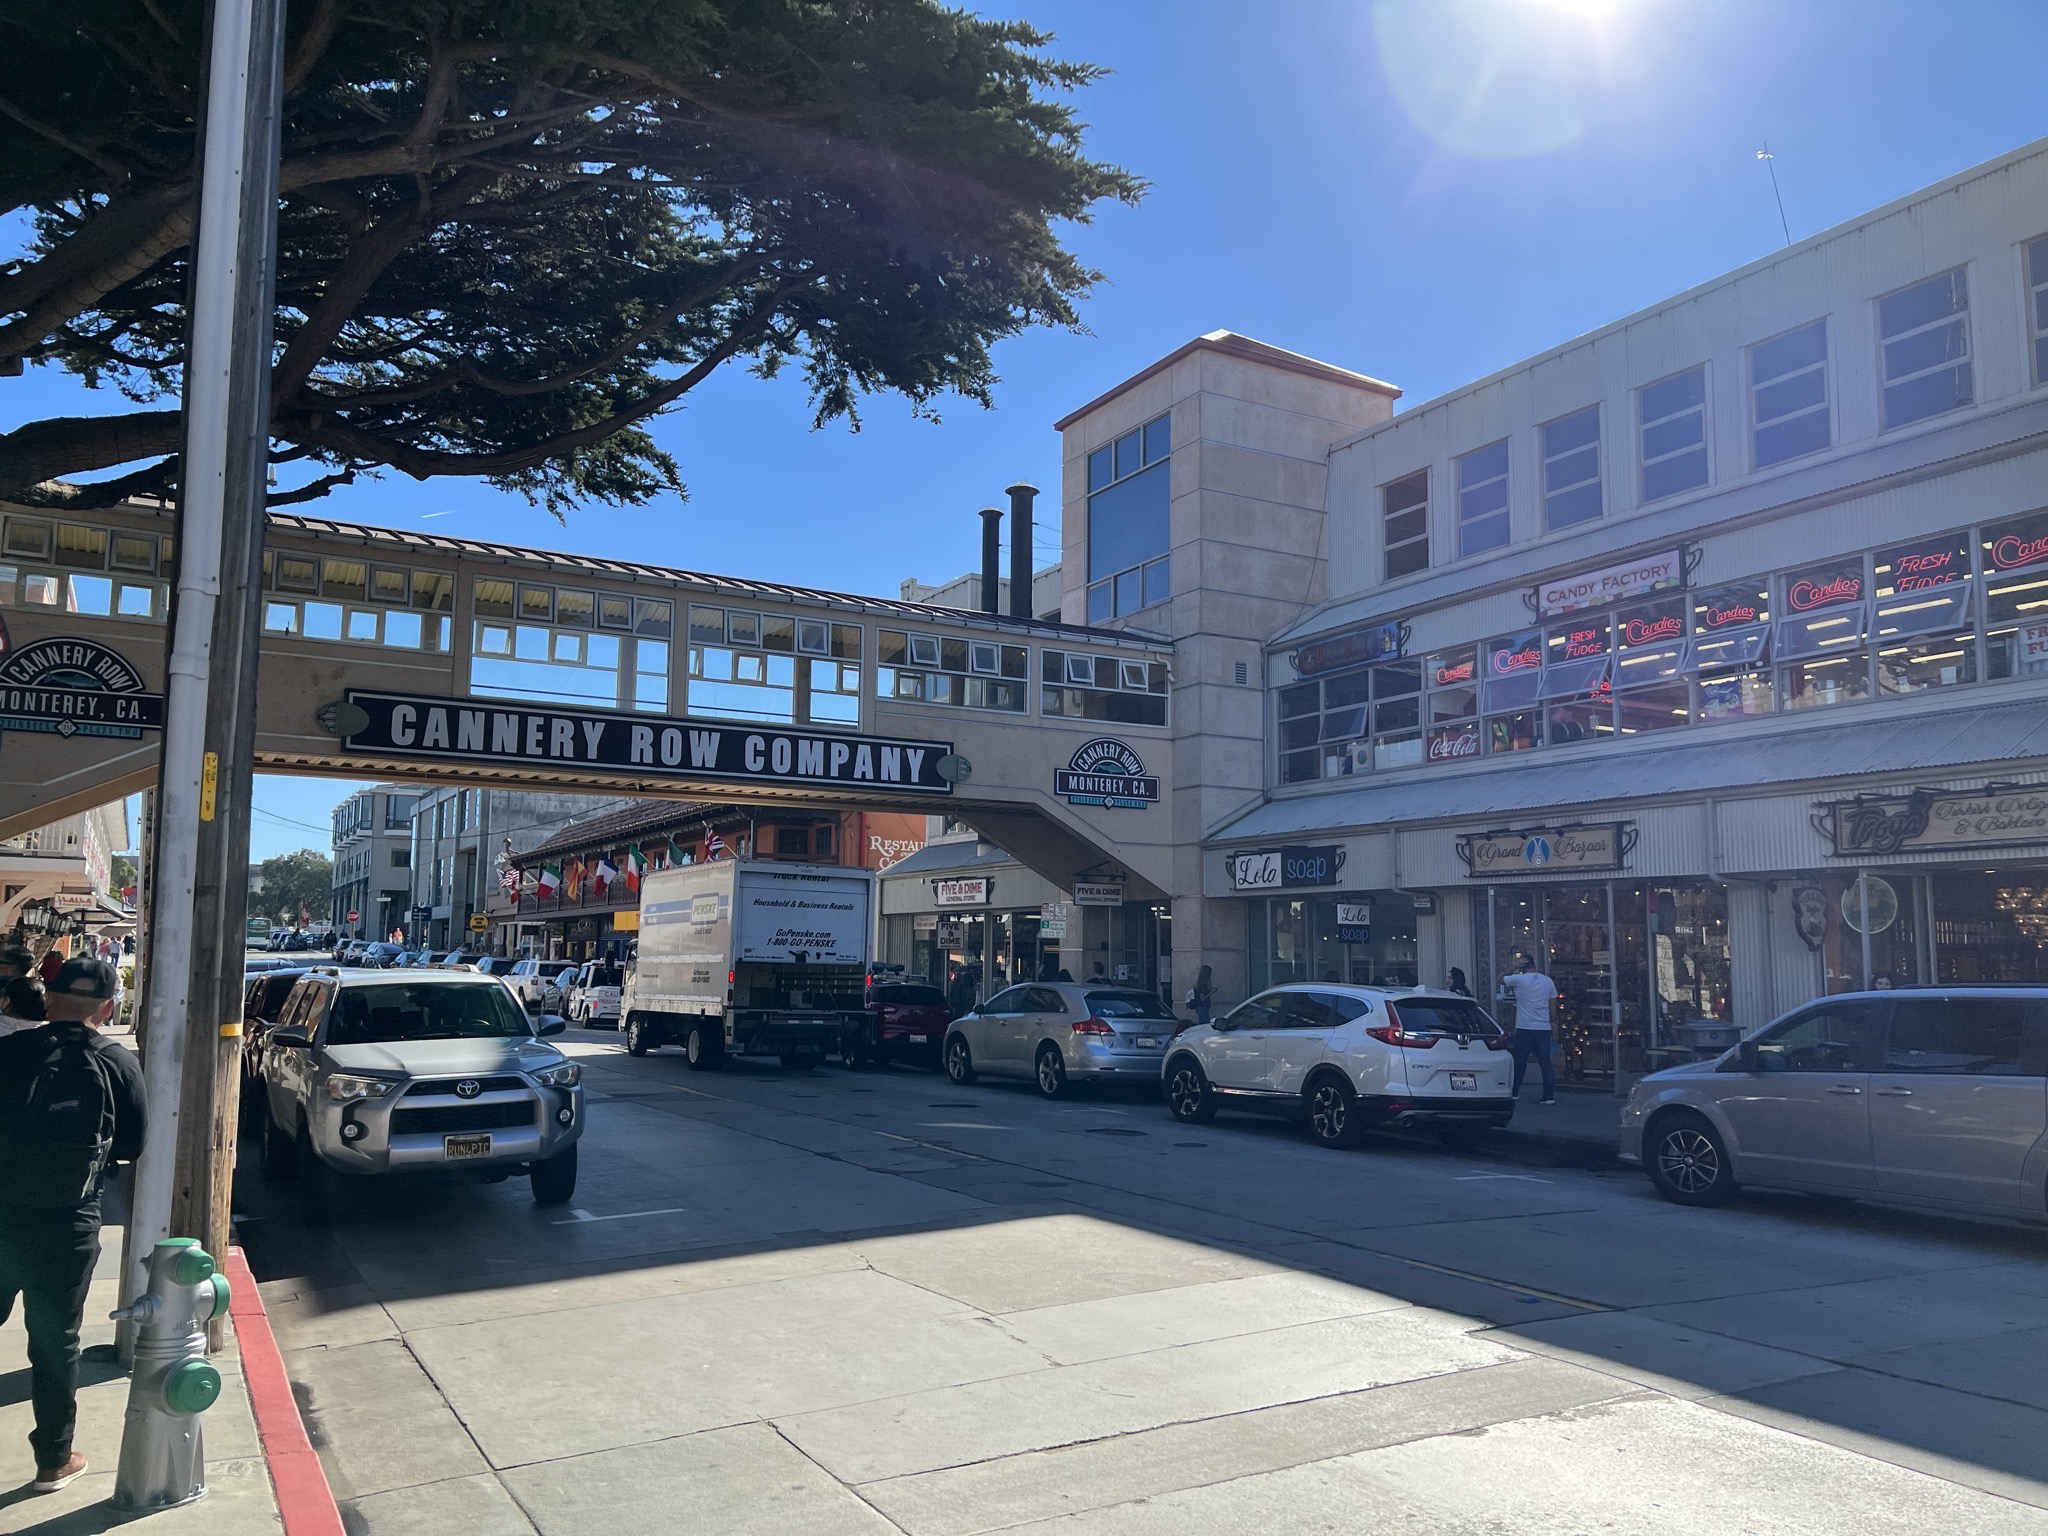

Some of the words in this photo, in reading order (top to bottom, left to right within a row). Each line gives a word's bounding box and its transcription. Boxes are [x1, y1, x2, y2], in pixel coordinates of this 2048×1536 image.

[1895, 551, 1953, 575] FRESH
[1547, 582, 1596, 604] CANDY
[1602, 563, 1671, 590] FACTORY
[1790, 577, 1860, 610] Candies
[1706, 605, 1755, 626] Candies
[1570, 629, 1596, 643] FRESH
[1626, 616, 1682, 645] Candies
[1565, 642, 1603, 659] FUDGE
[9, 645, 97, 682] CANNERY
[94, 656, 133, 689] ROW
[1494, 648, 1541, 673] Candies
[1437, 667, 1471, 683] Candies
[116, 699, 147, 720] CA.
[391, 704, 606, 760] CANNERY
[630, 725, 720, 769] ROW
[744, 735, 925, 783] COMPANY
[1078, 744, 1121, 770] CANNERY
[1120, 751, 1140, 774] ROW
[1068, 776, 1128, 795] MONTEREY,
[1132, 781, 1149, 795] CA.
[1937, 801, 1991, 820] Turkish
[1955, 819, 1971, 835] &
[870, 836, 926, 857] RESTAU
[1477, 842, 1525, 867] Grand
[1553, 836, 1610, 861] Bazaar
[1238, 856, 1277, 885] Lola
[1287, 856, 1326, 884] soap
[941, 884, 957, 895] FIVE
[958, 883, 963, 894] &
[964, 882, 983, 894] DIME
[1077, 887, 1095, 895] FIVE
[1102, 888, 1121, 896] DIME
[693, 904, 717, 915] PENSKE
[753, 899, 791, 908] Household
[797, 901, 828, 910] Business
[829, 903, 854, 911] Rentals
[1342, 907, 1367, 922] Lola
[776, 928, 832, 938] GoPenske.com
[941, 923, 960, 931] FIVE
[1342, 928, 1368, 944] soap
[766, 938, 837, 948] 1-800-GO-PENSKE
[1504, 985, 1516, 994] OPE
